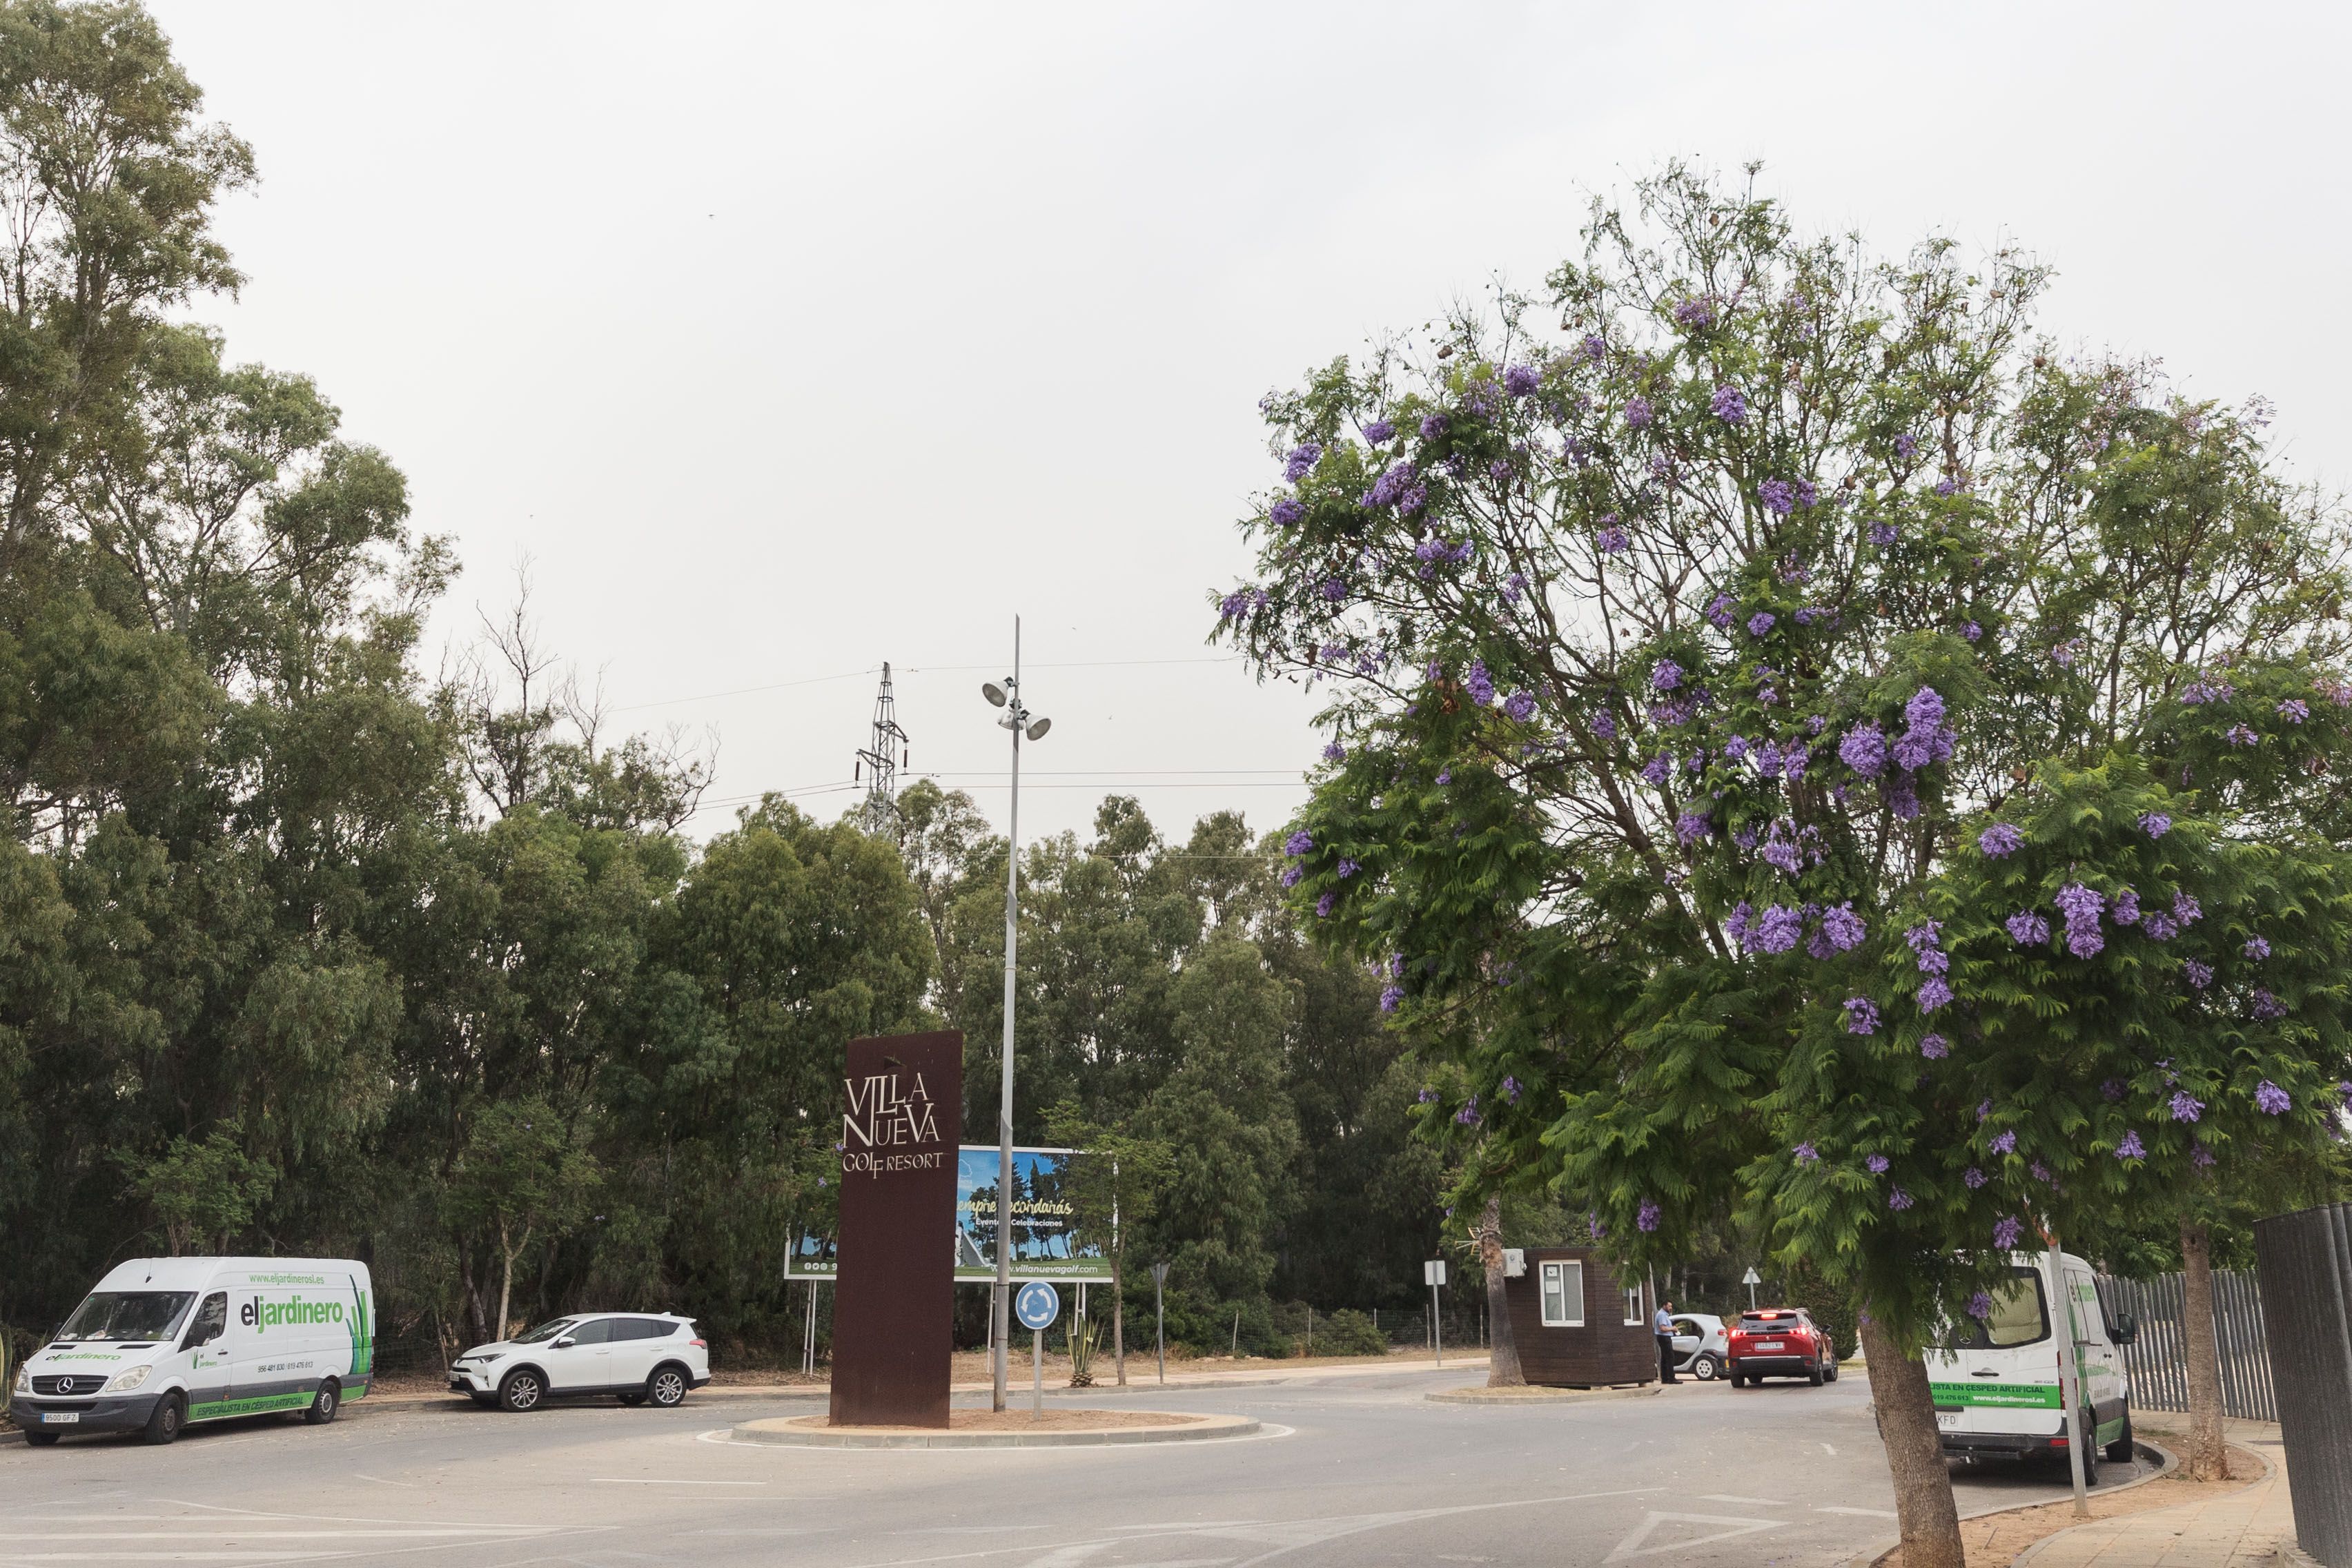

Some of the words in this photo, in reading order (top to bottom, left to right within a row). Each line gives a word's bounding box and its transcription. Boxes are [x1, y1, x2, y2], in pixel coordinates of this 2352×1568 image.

[844, 1072, 930, 1116] VILLA
[843, 1102, 941, 1149] NUEVA
[843, 1151, 883, 1179] GOLF
[886, 1152, 944, 1172] RESORT
[1010, 1219, 1064, 1227] Celebraciones
[1999, 1385, 2046, 1393] ARTIFICIAL
[197, 1402, 241, 1415] ESPECIALISTA
[242, 1402, 251, 1411] EN
[274, 1396, 304, 1407] ARTIFICIAL
